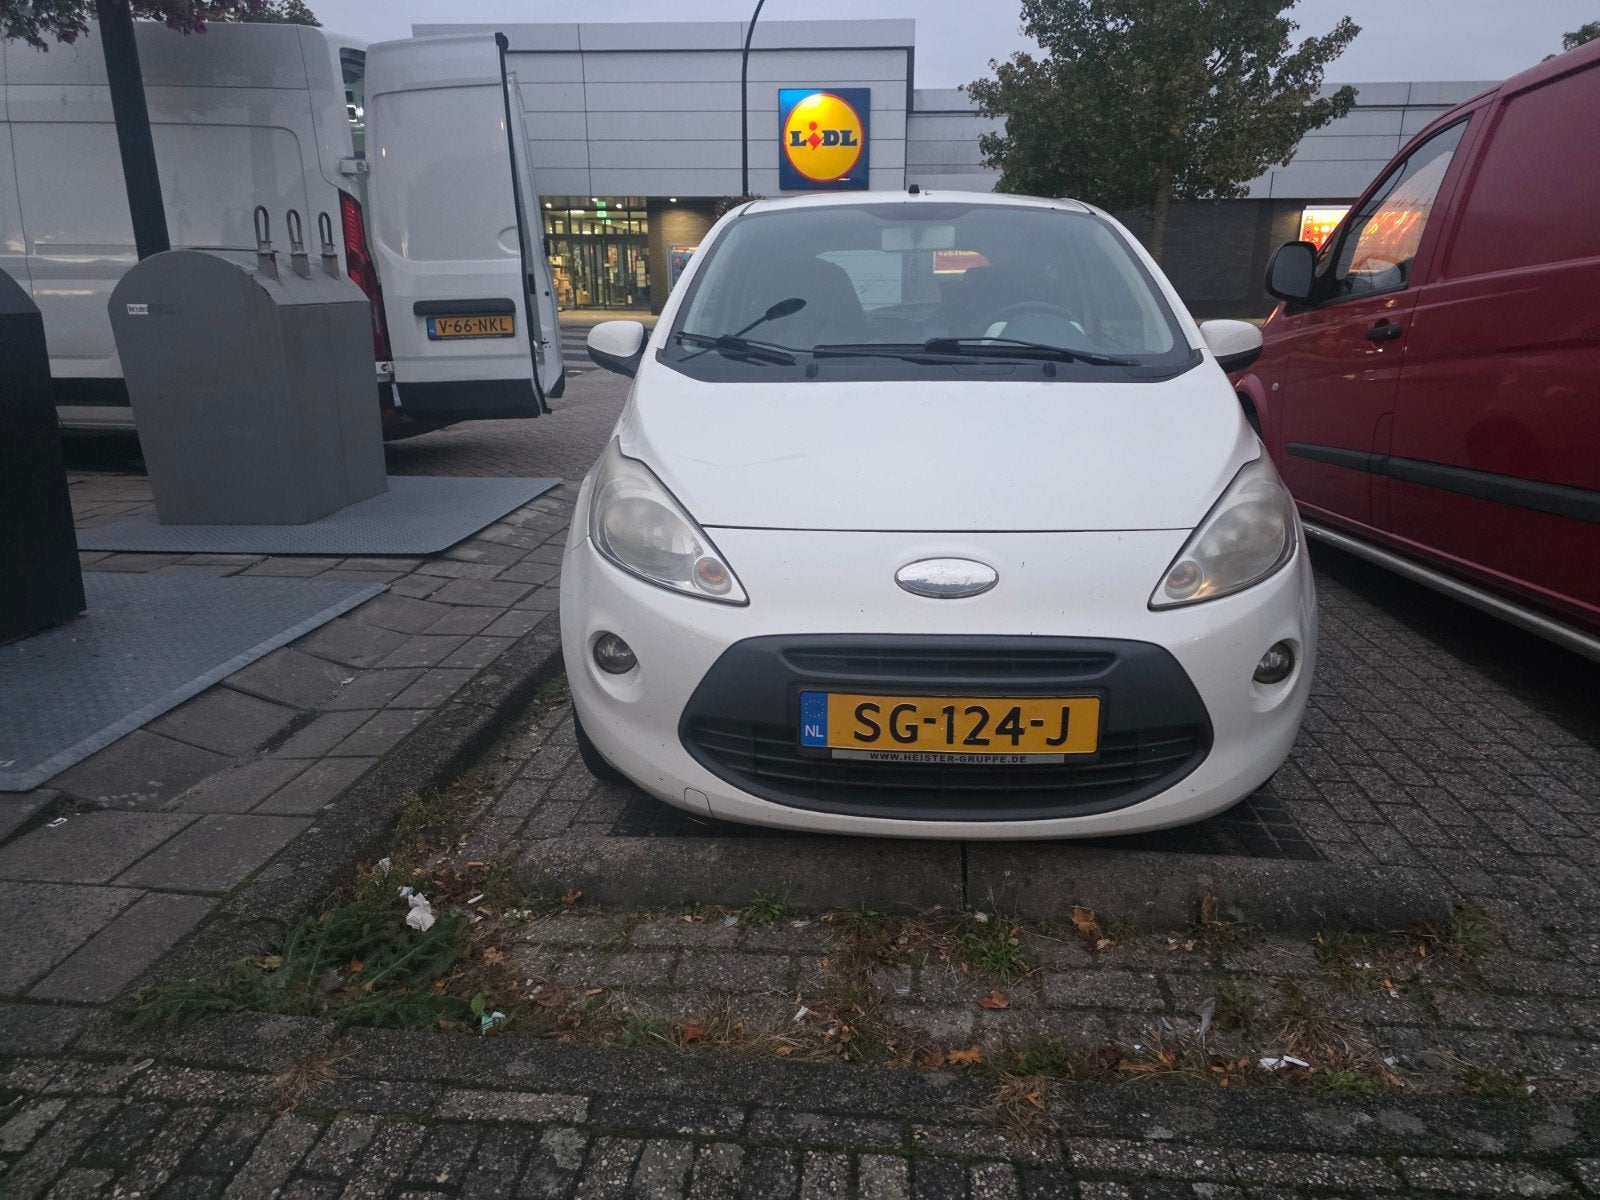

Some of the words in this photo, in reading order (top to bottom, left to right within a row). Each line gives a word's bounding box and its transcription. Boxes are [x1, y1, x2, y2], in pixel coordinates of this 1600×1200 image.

[438, 317, 508, 334] V-66-NKL
[804, 724, 824, 739] NL
[853, 702, 1071, 747] SG-124-J
[869, 752, 1027, 764] WWW.HEISTER-GRUPPE.DE
